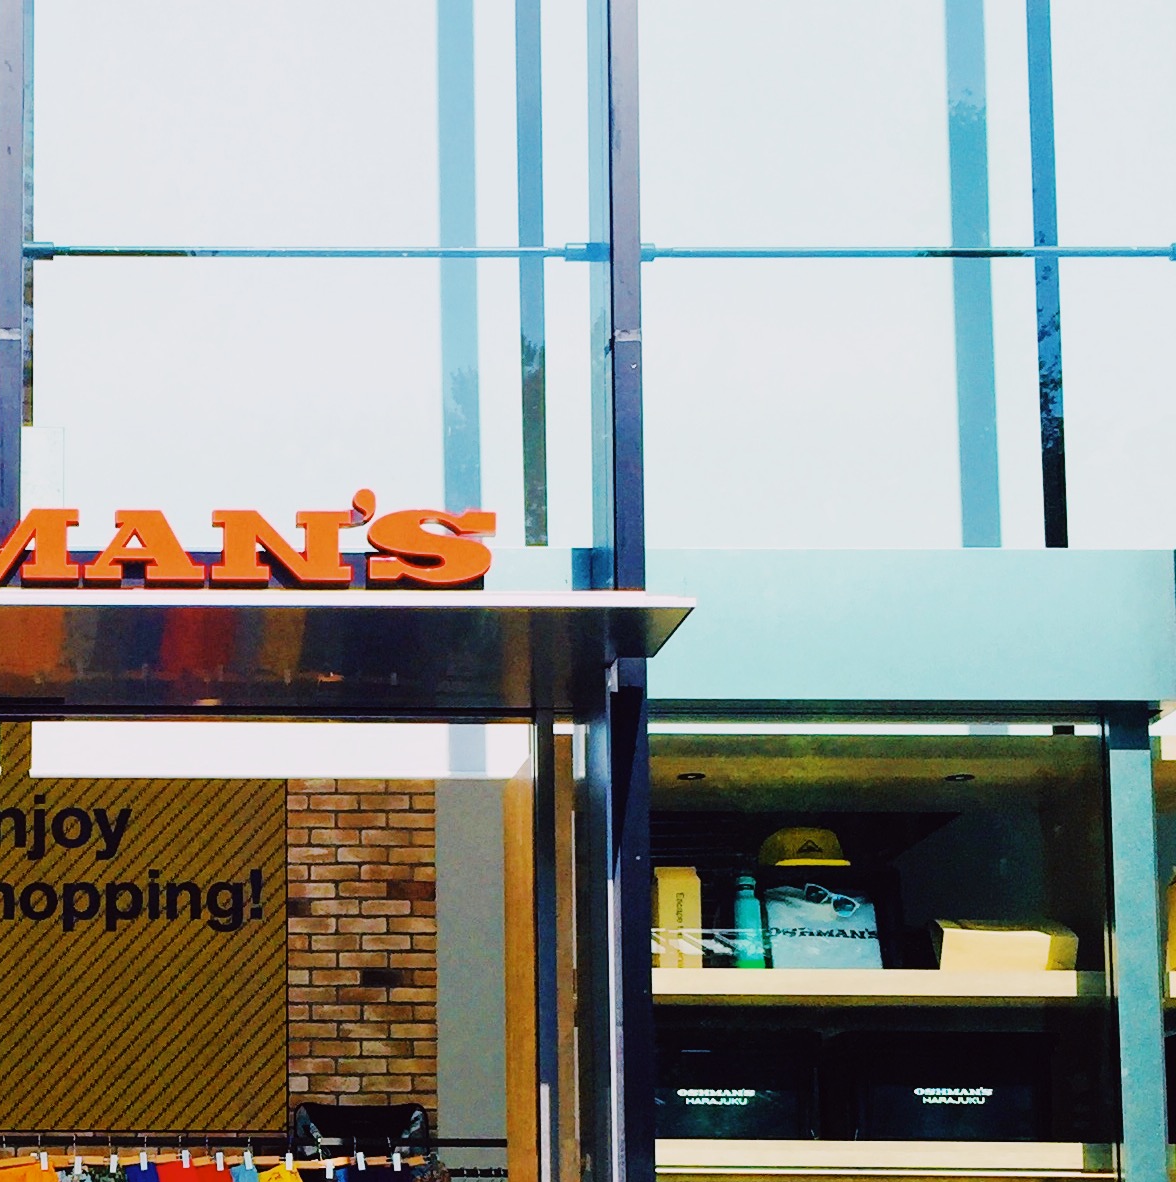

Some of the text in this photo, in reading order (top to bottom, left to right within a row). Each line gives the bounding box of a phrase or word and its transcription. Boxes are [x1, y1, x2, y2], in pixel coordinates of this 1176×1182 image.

[769, 926, 879, 940] OSHMAN'S
[676, 1088, 756, 1097] OSHMAN'S
[913, 1086, 994, 1096] OSHMAN'S
[685, 1097, 748, 1105] HARAJUKU
[922, 1096, 986, 1105] HARAJUKU
